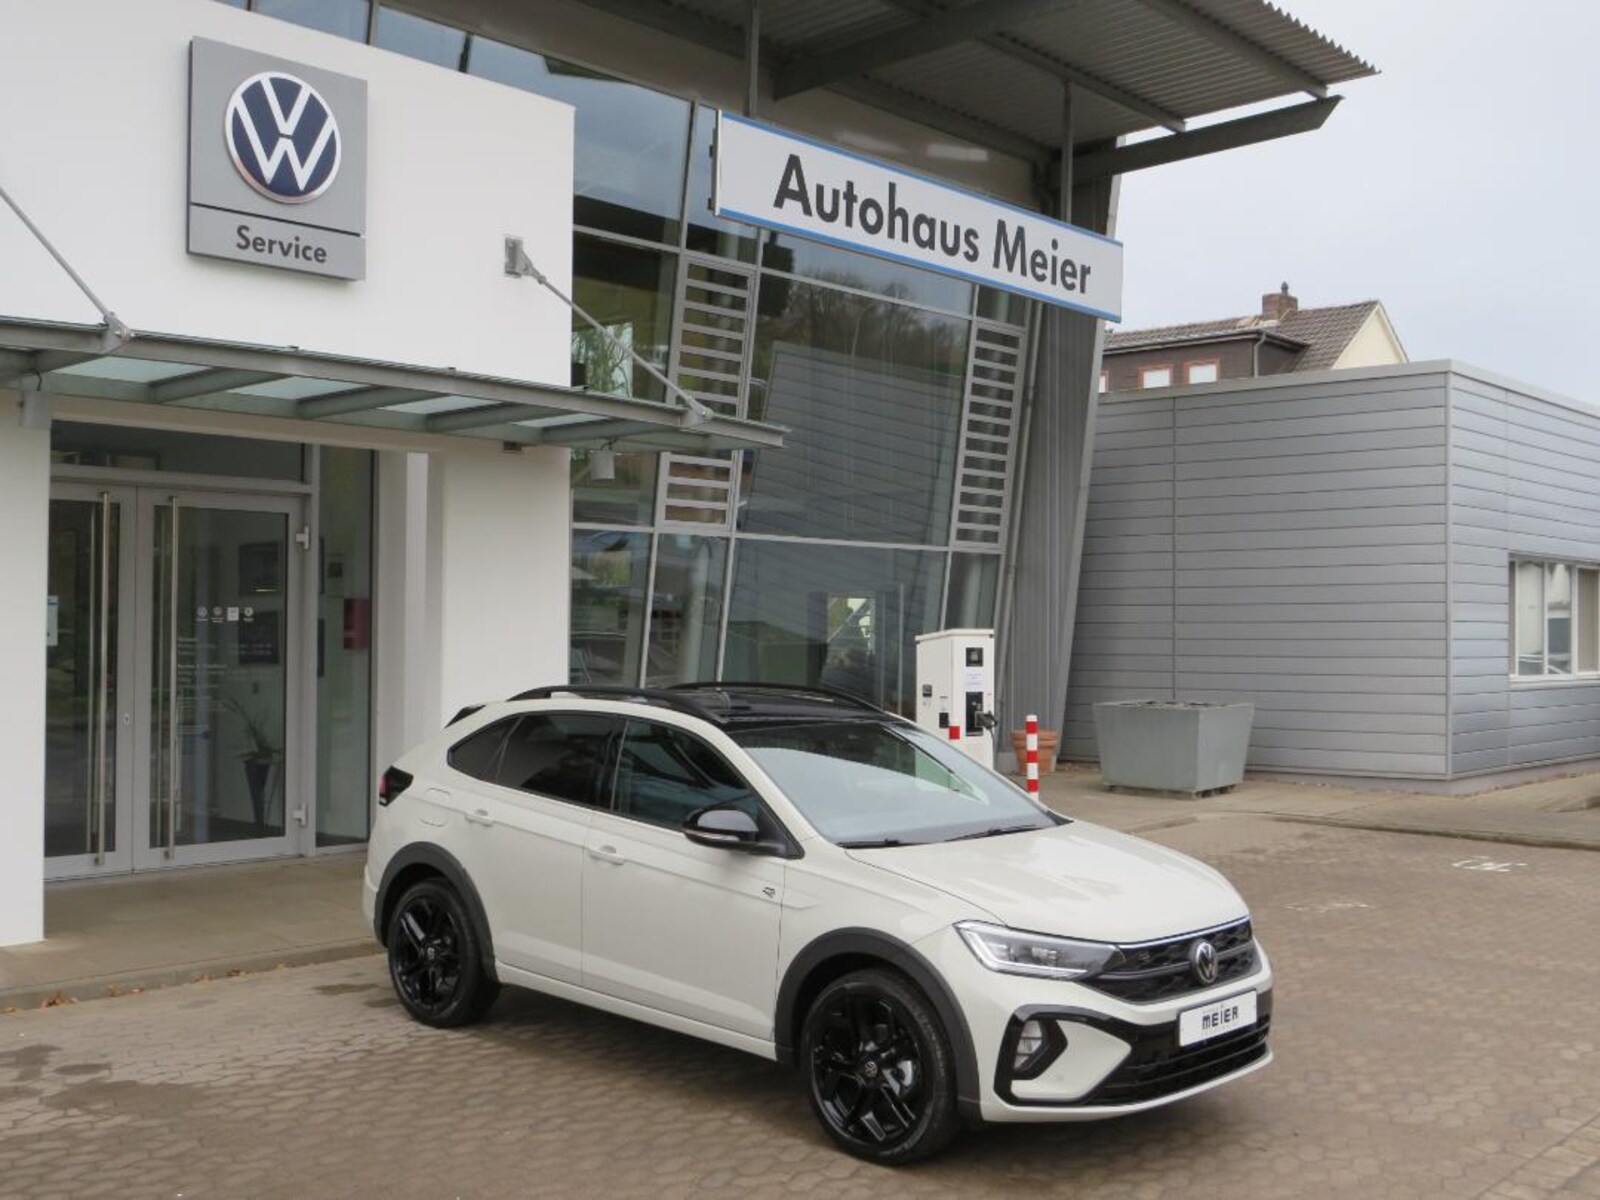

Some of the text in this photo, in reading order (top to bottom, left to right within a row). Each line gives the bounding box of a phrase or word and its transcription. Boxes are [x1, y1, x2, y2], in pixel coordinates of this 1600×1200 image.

[227, 72, 340, 203] VW
[236, 225, 327, 263] Service
[773, 154, 1091, 294] Autohaus Meier
